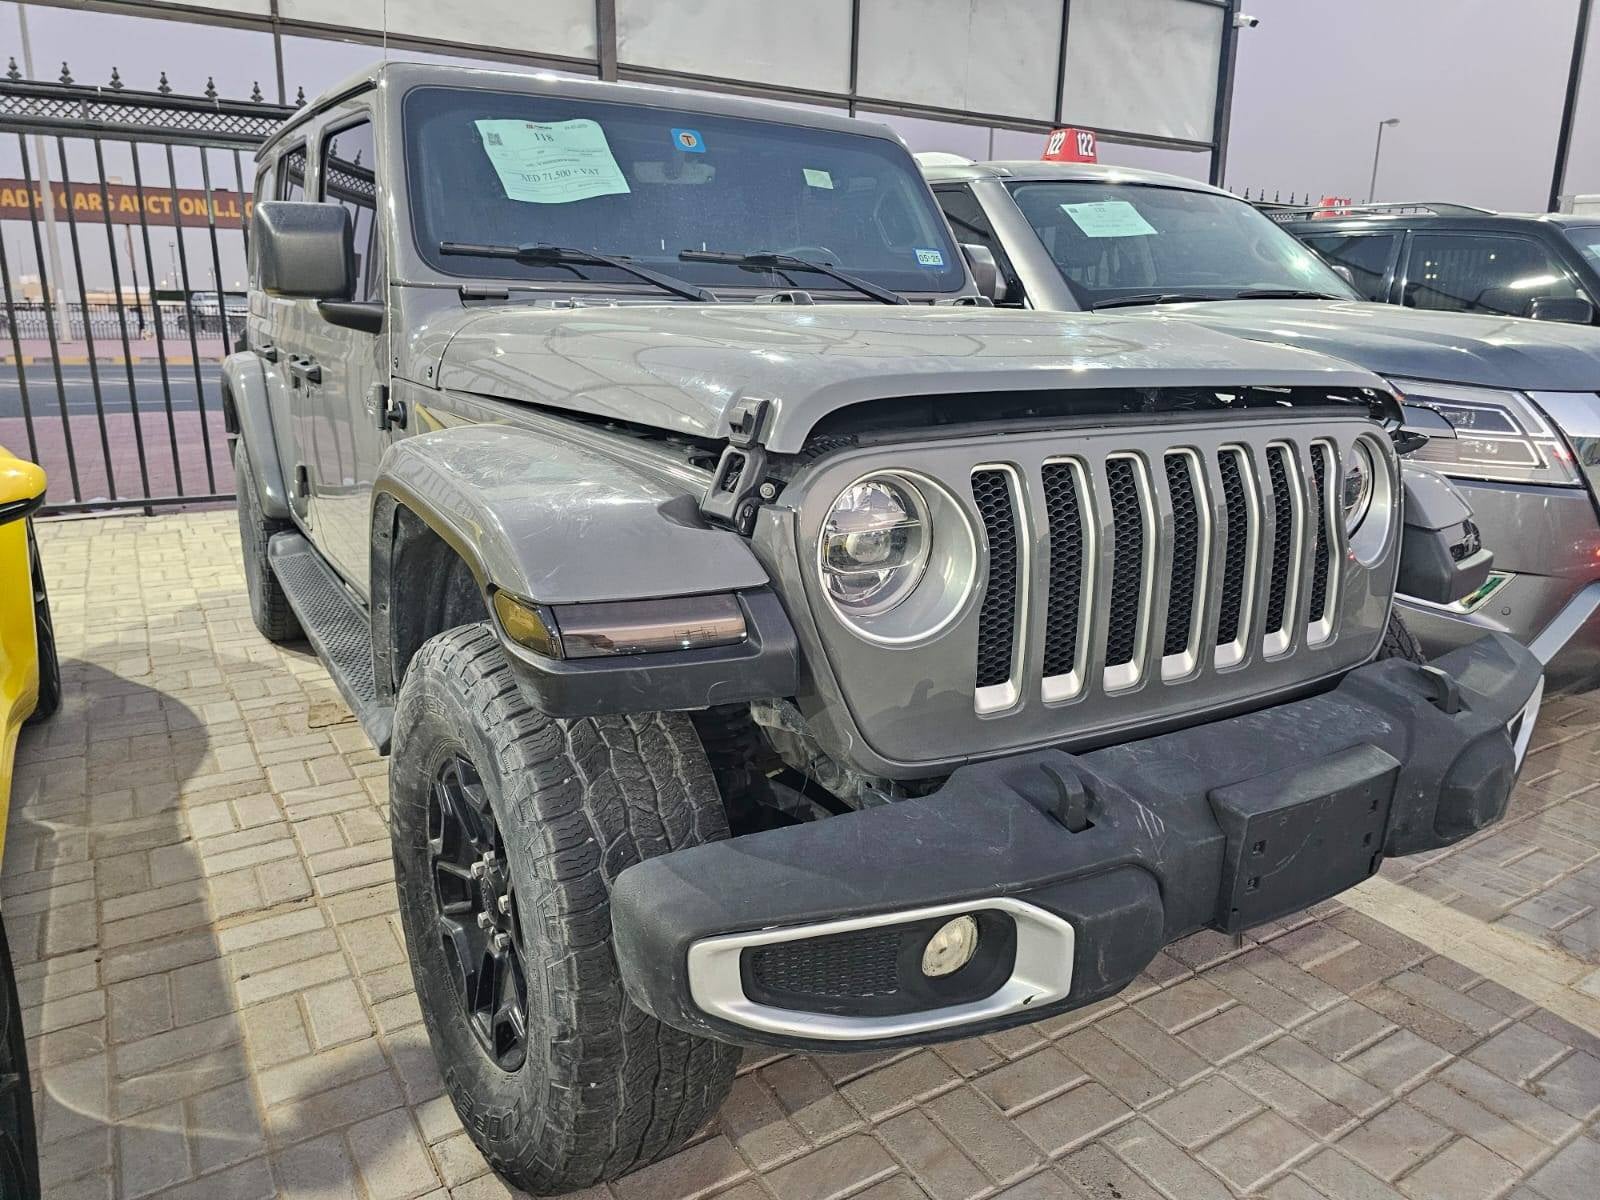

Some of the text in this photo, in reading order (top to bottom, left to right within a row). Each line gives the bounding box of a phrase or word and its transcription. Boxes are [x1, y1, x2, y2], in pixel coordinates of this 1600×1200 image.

[1046, 131, 1066, 156] 122
[1077, 132, 1095, 157] 122
[521, 173, 541, 183] AED
[580, 167, 600, 176] VAT
[59, 191, 116, 212] CARS
[119, 194, 208, 217] AUCTON
